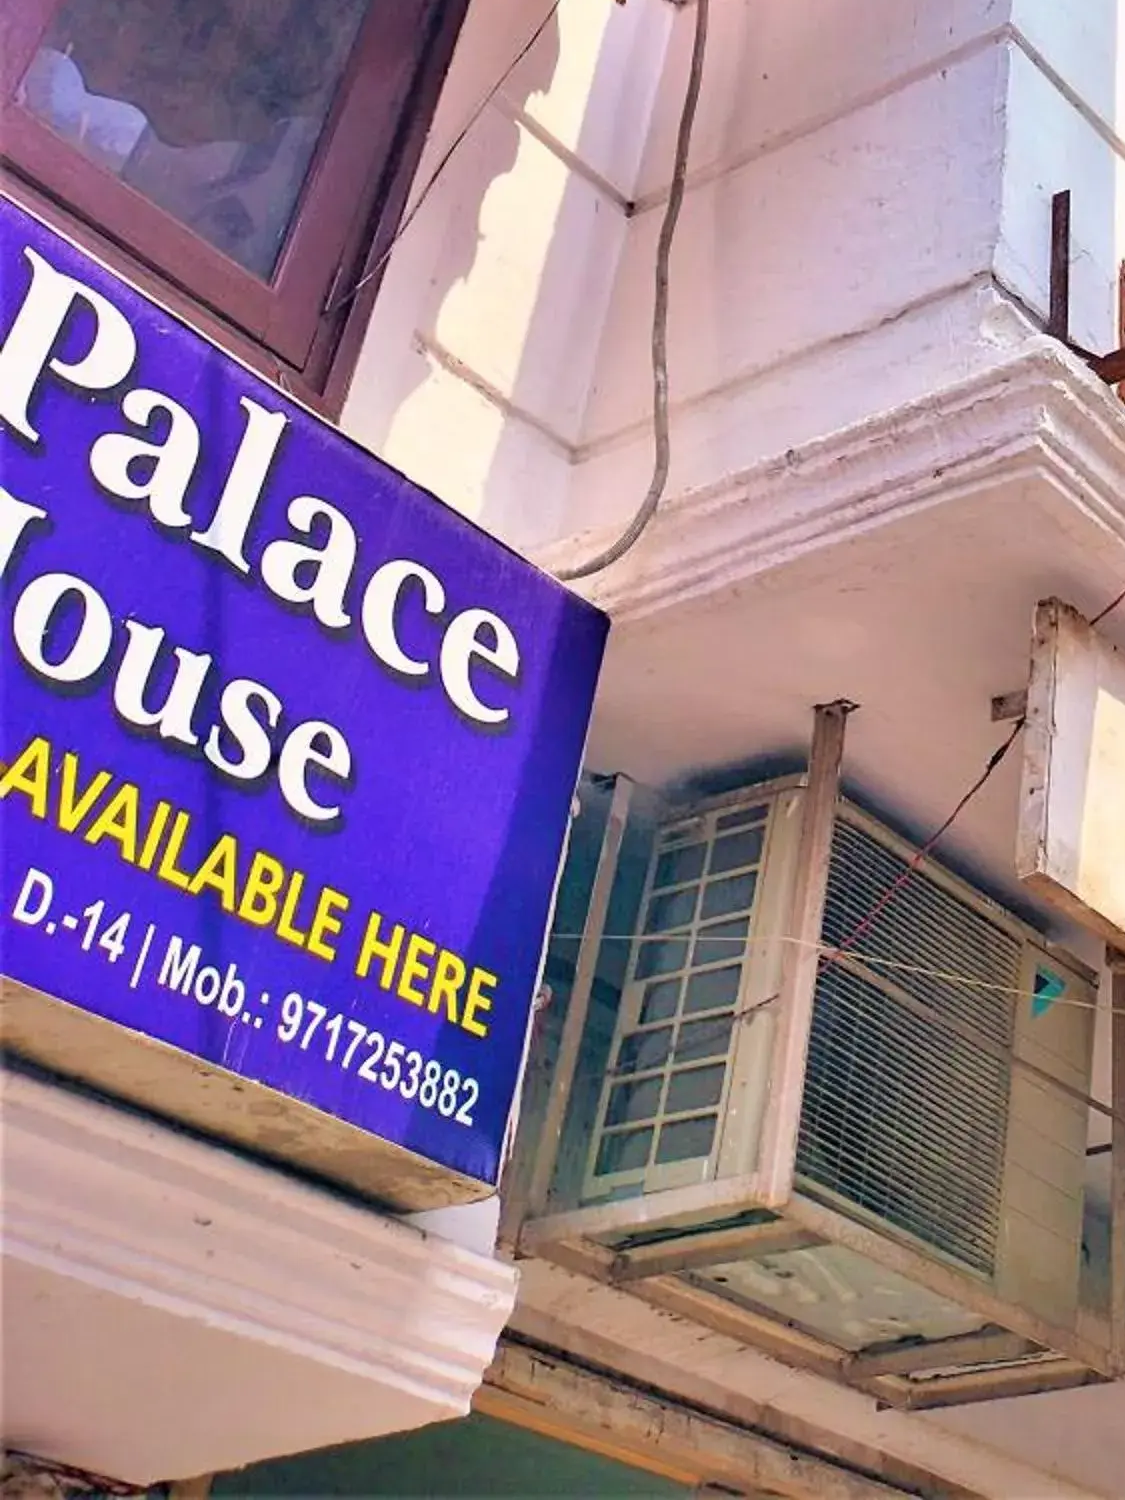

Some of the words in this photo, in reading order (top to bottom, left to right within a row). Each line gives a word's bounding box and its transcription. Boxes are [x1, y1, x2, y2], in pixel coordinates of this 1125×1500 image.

[0, 245, 523, 726] Palace
[0, 485, 355, 821] ouse
[0, 737, 349, 961] AVAILABLE
[355, 912, 498, 1038] HERE
[277, 992, 480, 1126] 9717253882
